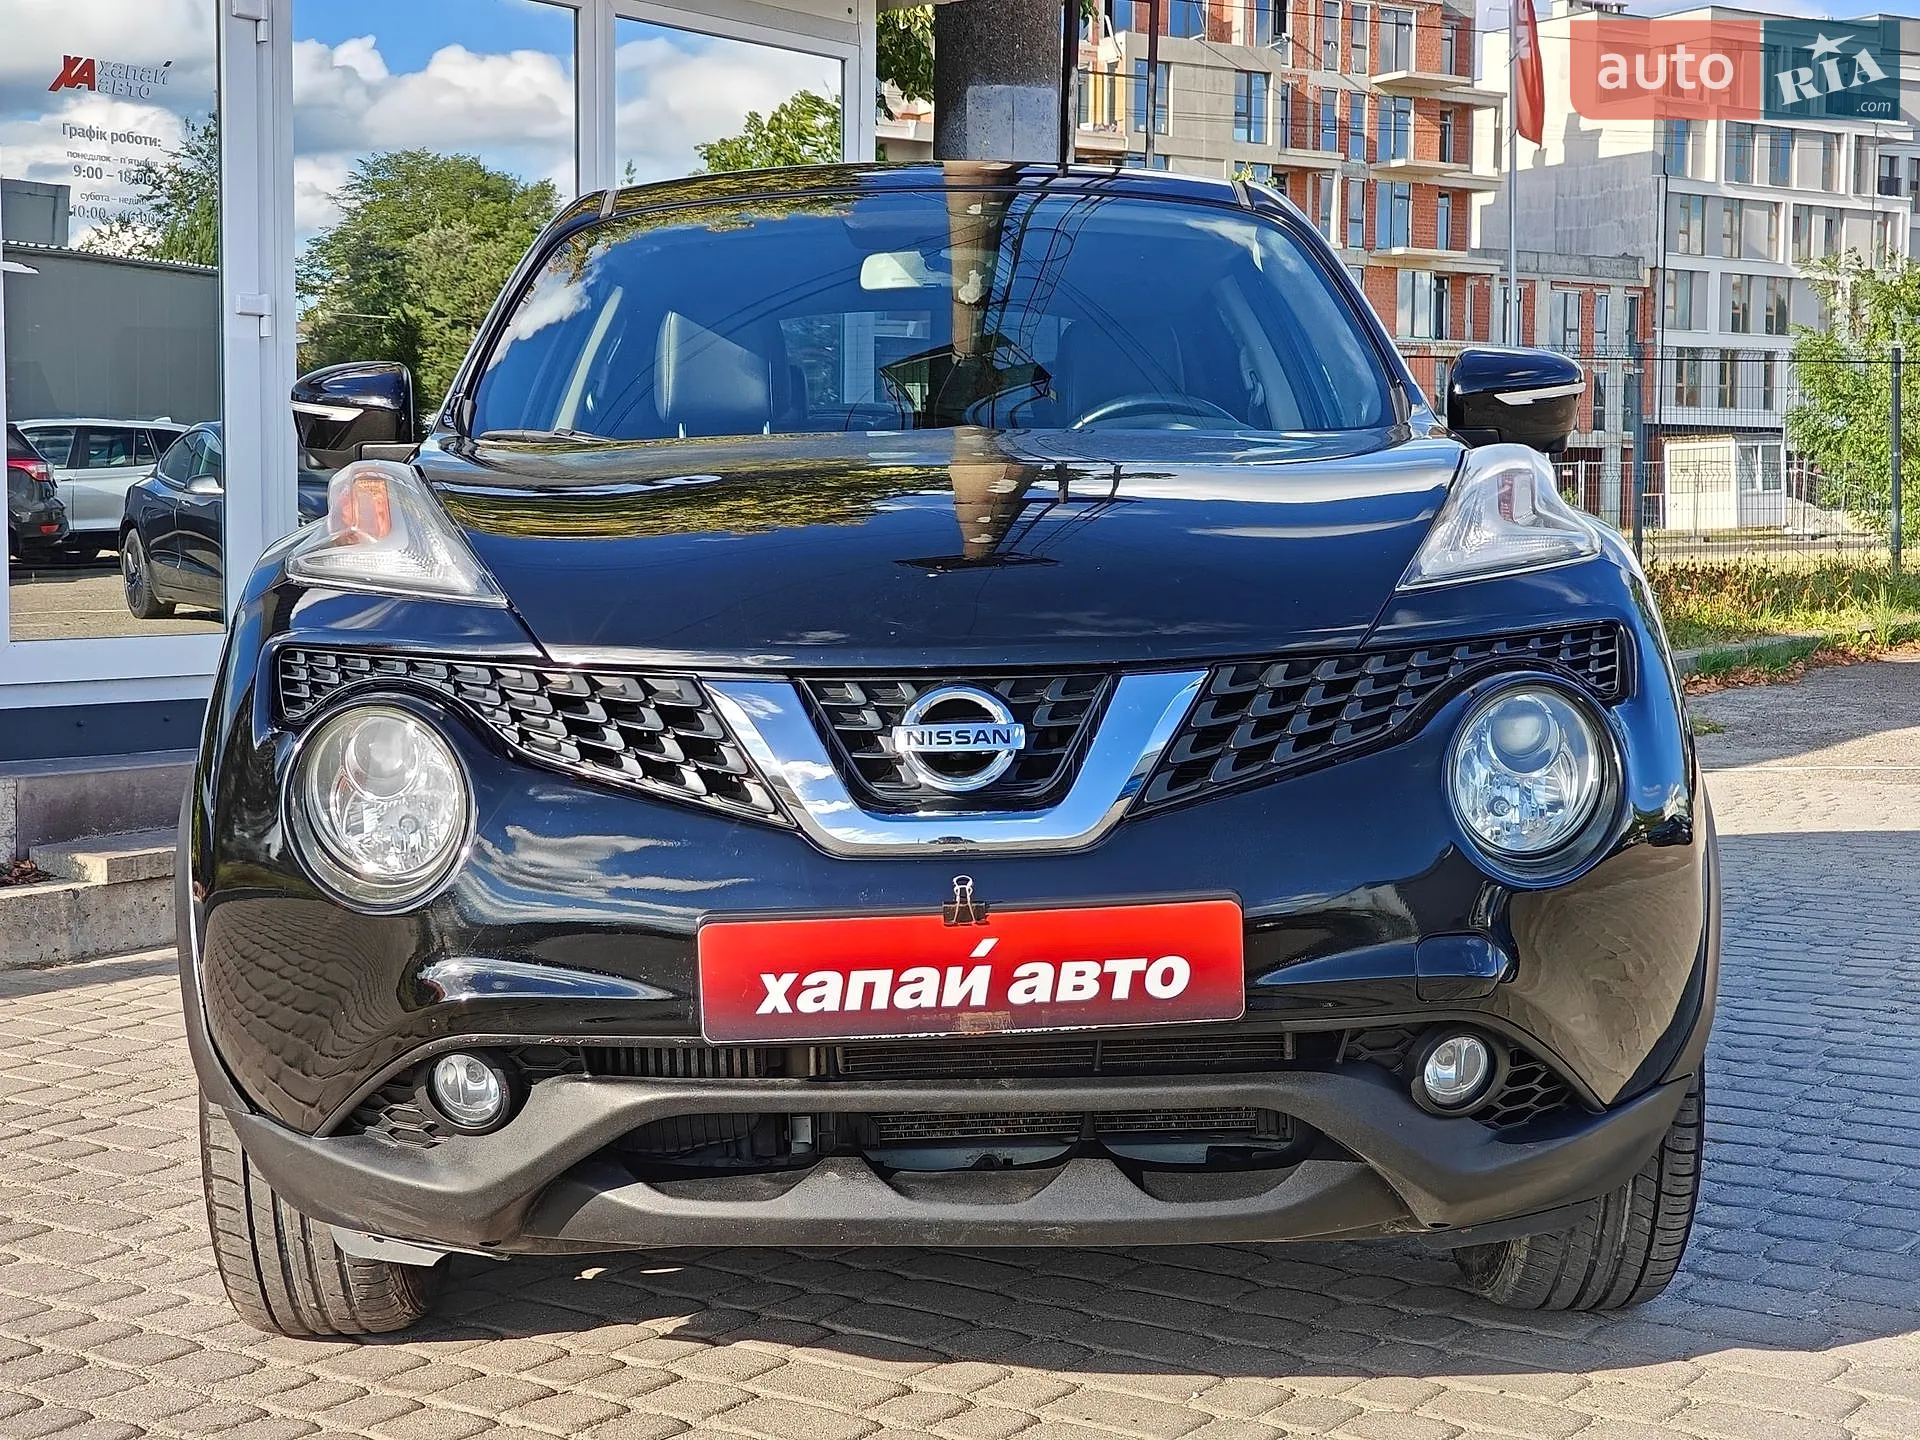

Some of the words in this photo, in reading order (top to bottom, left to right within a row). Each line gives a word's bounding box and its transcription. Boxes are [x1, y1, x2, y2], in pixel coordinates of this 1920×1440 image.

[97, 78, 151, 100] авто
[62, 122, 108, 142] Графік
[110, 131, 162, 148] роботи:
[66, 150, 112, 163] понеділок
[73, 164, 103, 180] 9:00
[117, 169, 153, 185] 18:00
[80, 191, 110, 203] субота
[71, 204, 106, 220] 10:00
[906, 729, 1011, 746] NISSAN
[1007, 955, 1191, 1005] авто
